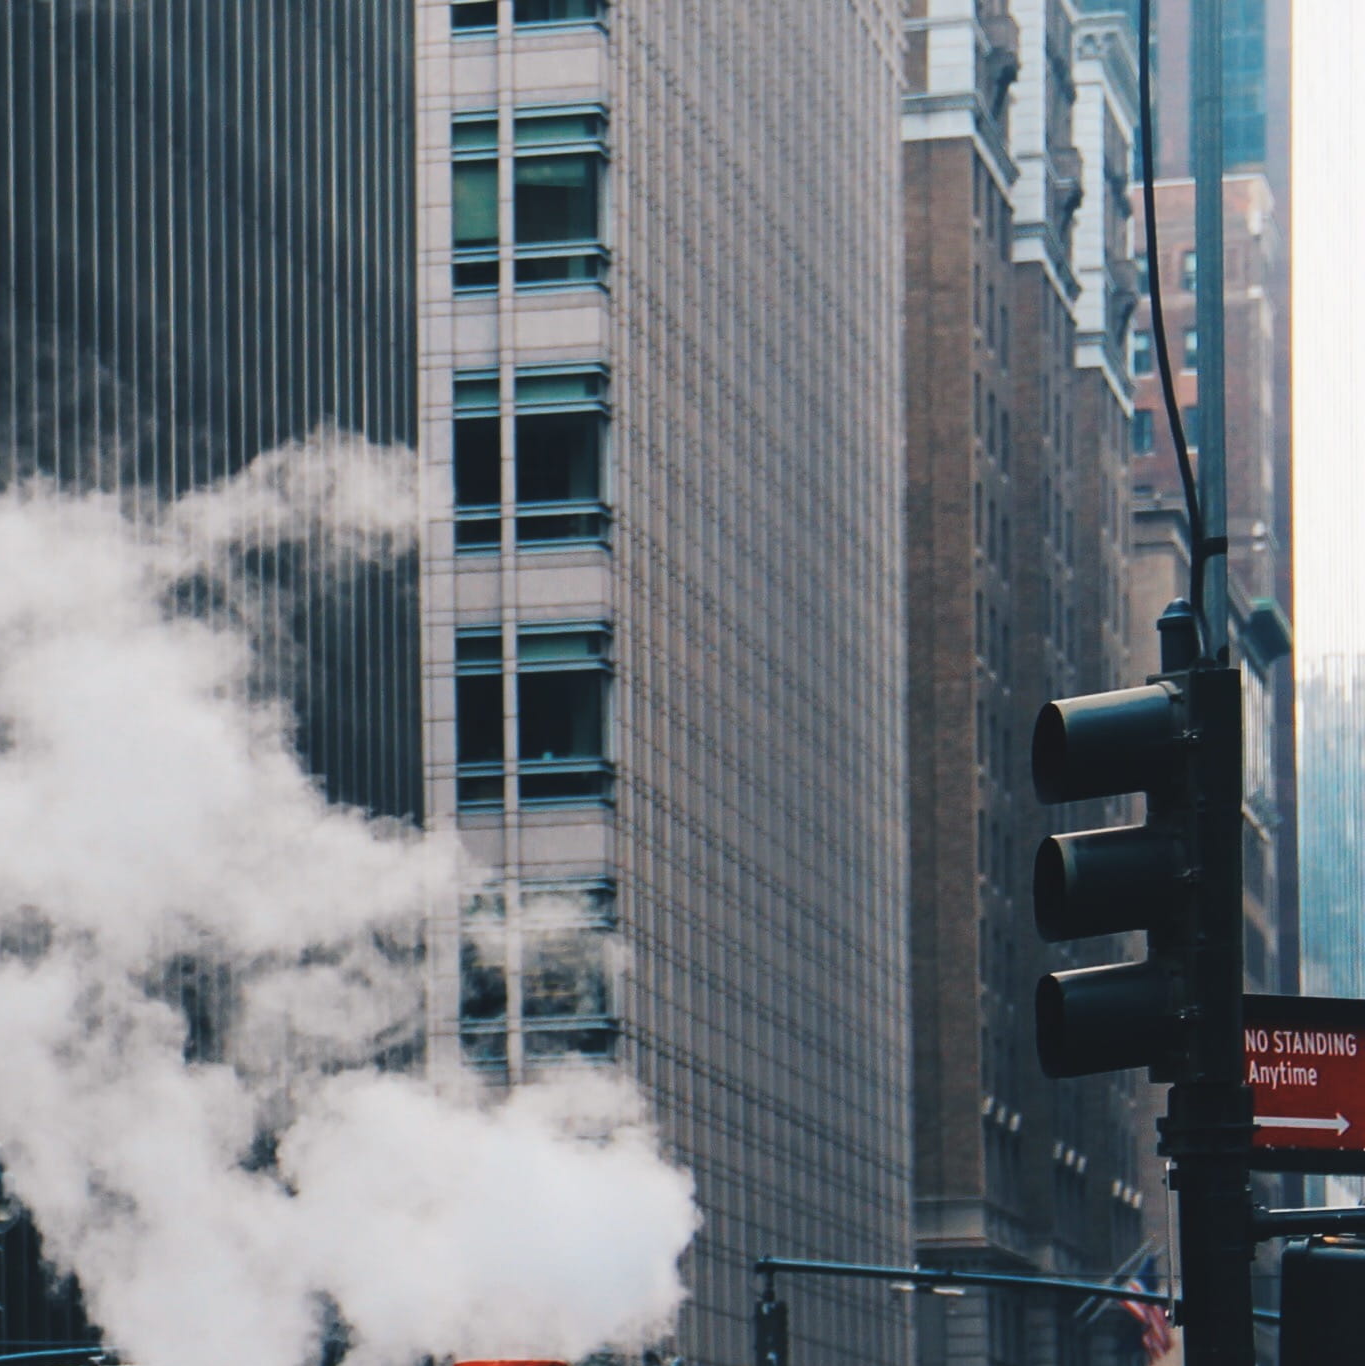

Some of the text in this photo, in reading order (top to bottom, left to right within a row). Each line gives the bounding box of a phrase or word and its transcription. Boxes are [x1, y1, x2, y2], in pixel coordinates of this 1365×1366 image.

[1245, 1029, 1357, 1056] NO STANDING
[1249, 1060, 1317, 1090] Anytime
